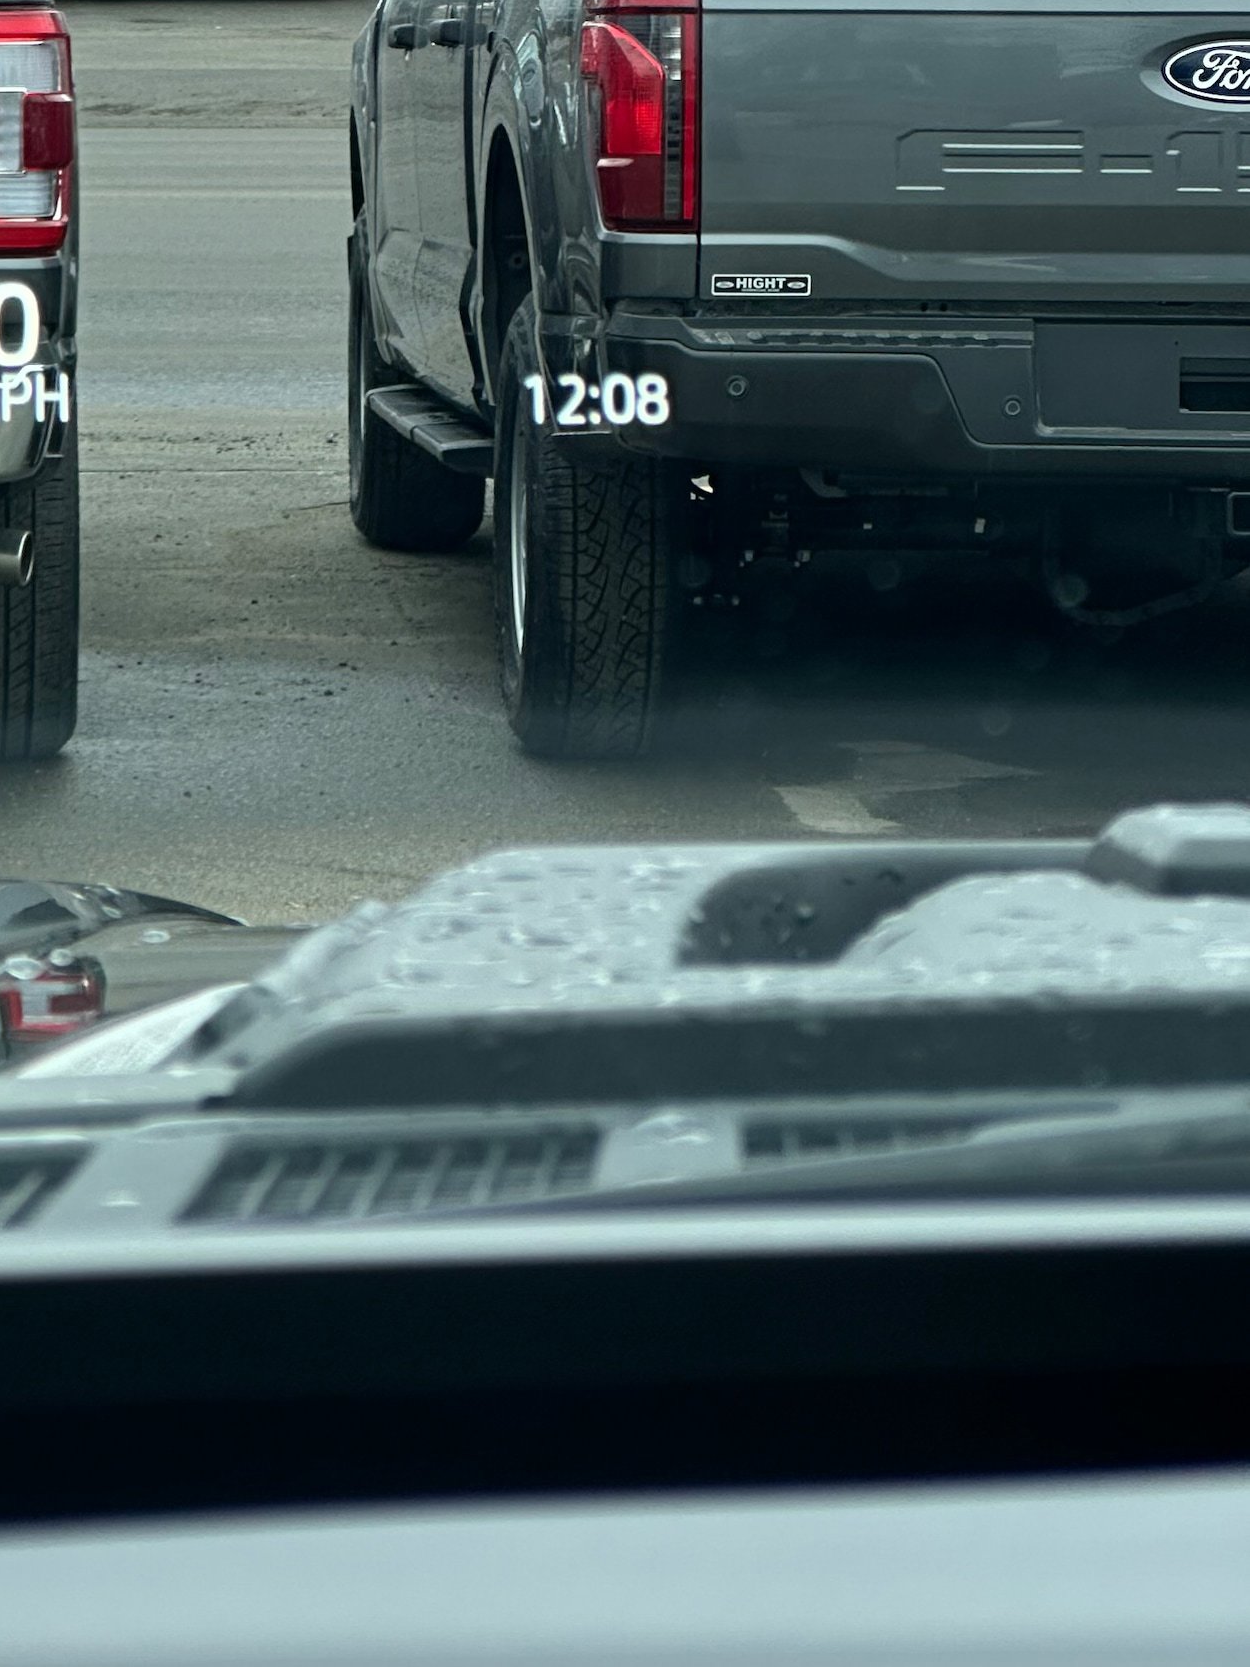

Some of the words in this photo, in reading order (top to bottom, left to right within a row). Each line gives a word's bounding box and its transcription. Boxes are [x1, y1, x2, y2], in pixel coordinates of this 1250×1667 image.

[895, 128, 1250, 193] F-1
[735, 277, 787, 290] HIGHT
[524, 372, 671, 426] 12:08
